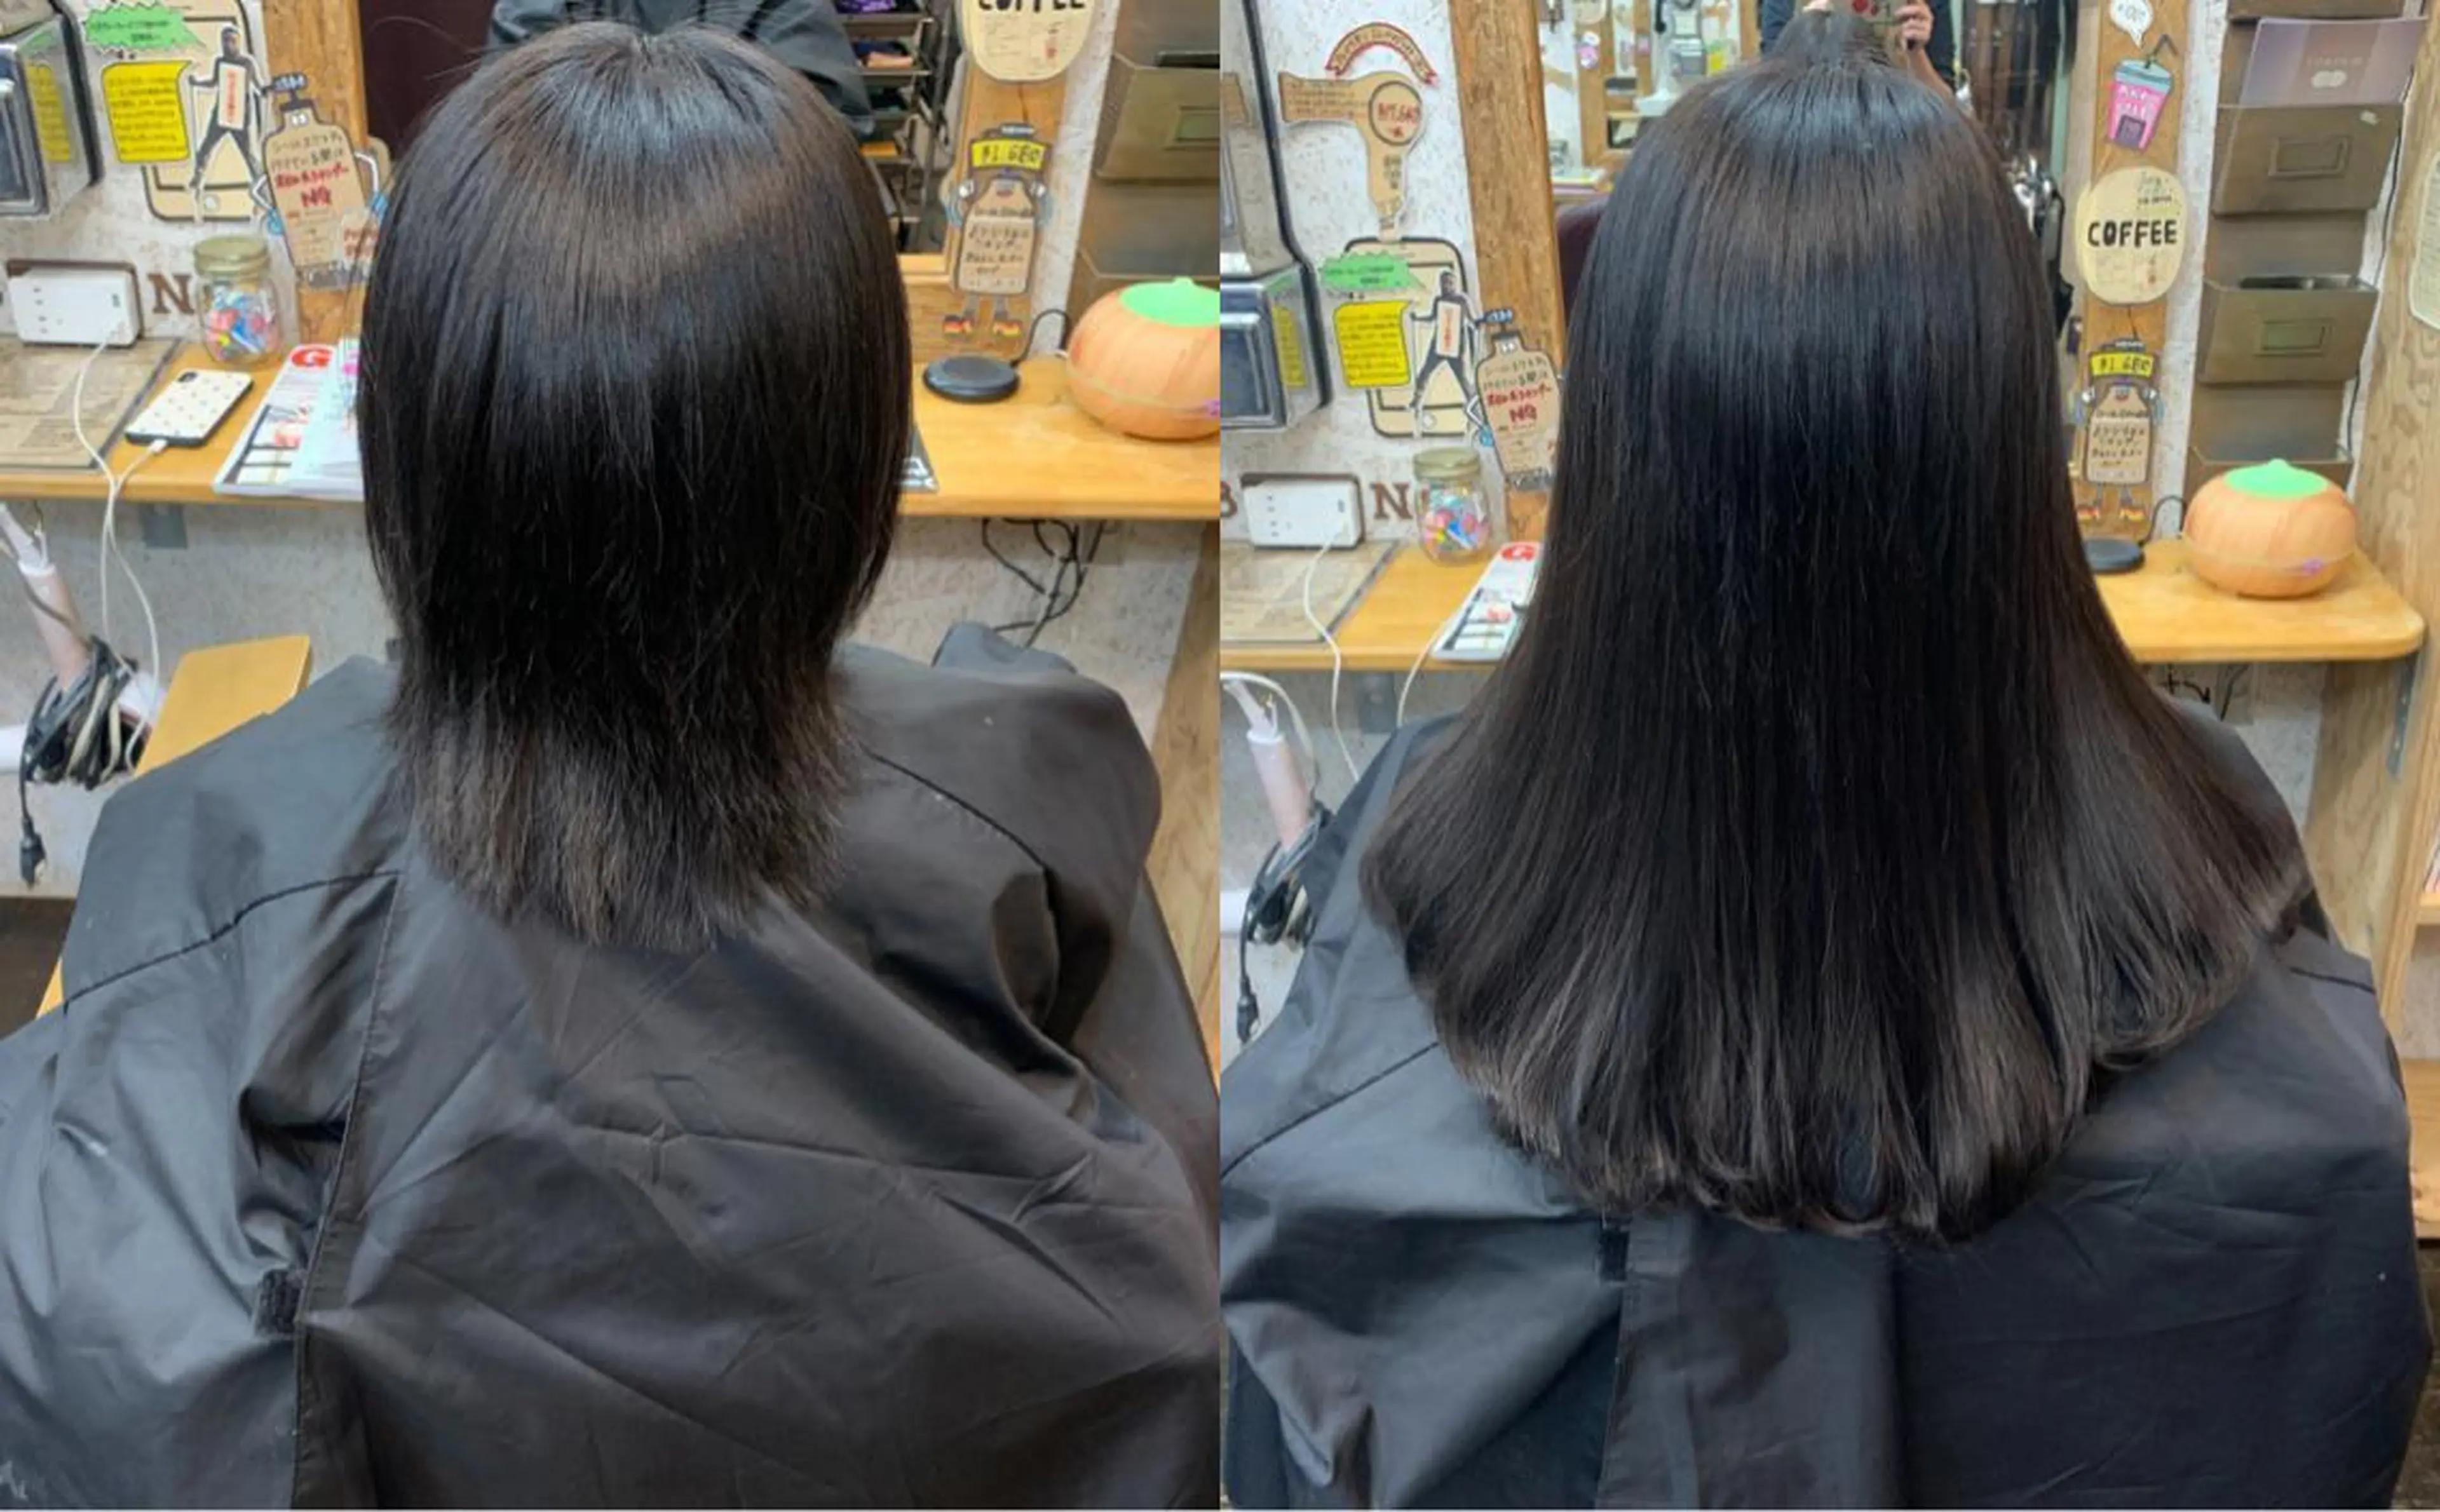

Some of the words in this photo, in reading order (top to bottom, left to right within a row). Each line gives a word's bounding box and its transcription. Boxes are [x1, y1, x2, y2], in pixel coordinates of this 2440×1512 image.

[2087, 220, 2177, 248] COFFEE
[147, 273, 195, 314] N
[1370, 482, 1413, 520] N
